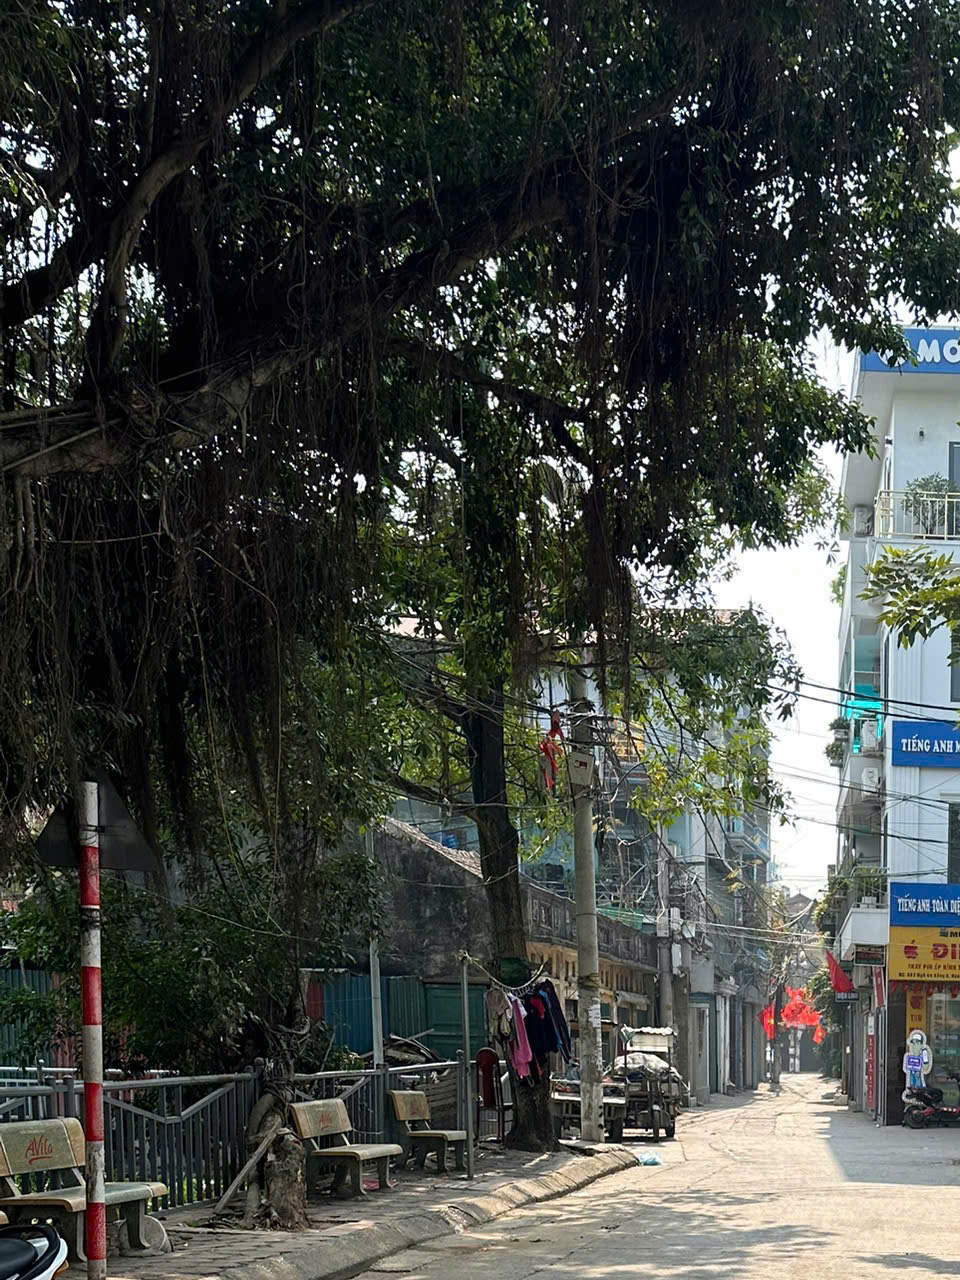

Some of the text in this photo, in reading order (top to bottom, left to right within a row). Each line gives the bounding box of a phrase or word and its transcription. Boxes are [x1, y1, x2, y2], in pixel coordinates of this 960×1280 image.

[901, 734, 931, 752] TIẾNG
[933, 739, 953, 753] ANH
[897, 894, 916, 912] TIẾNG
[917, 899, 931, 912] ANH
[932, 896, 949, 913] TOÀN
